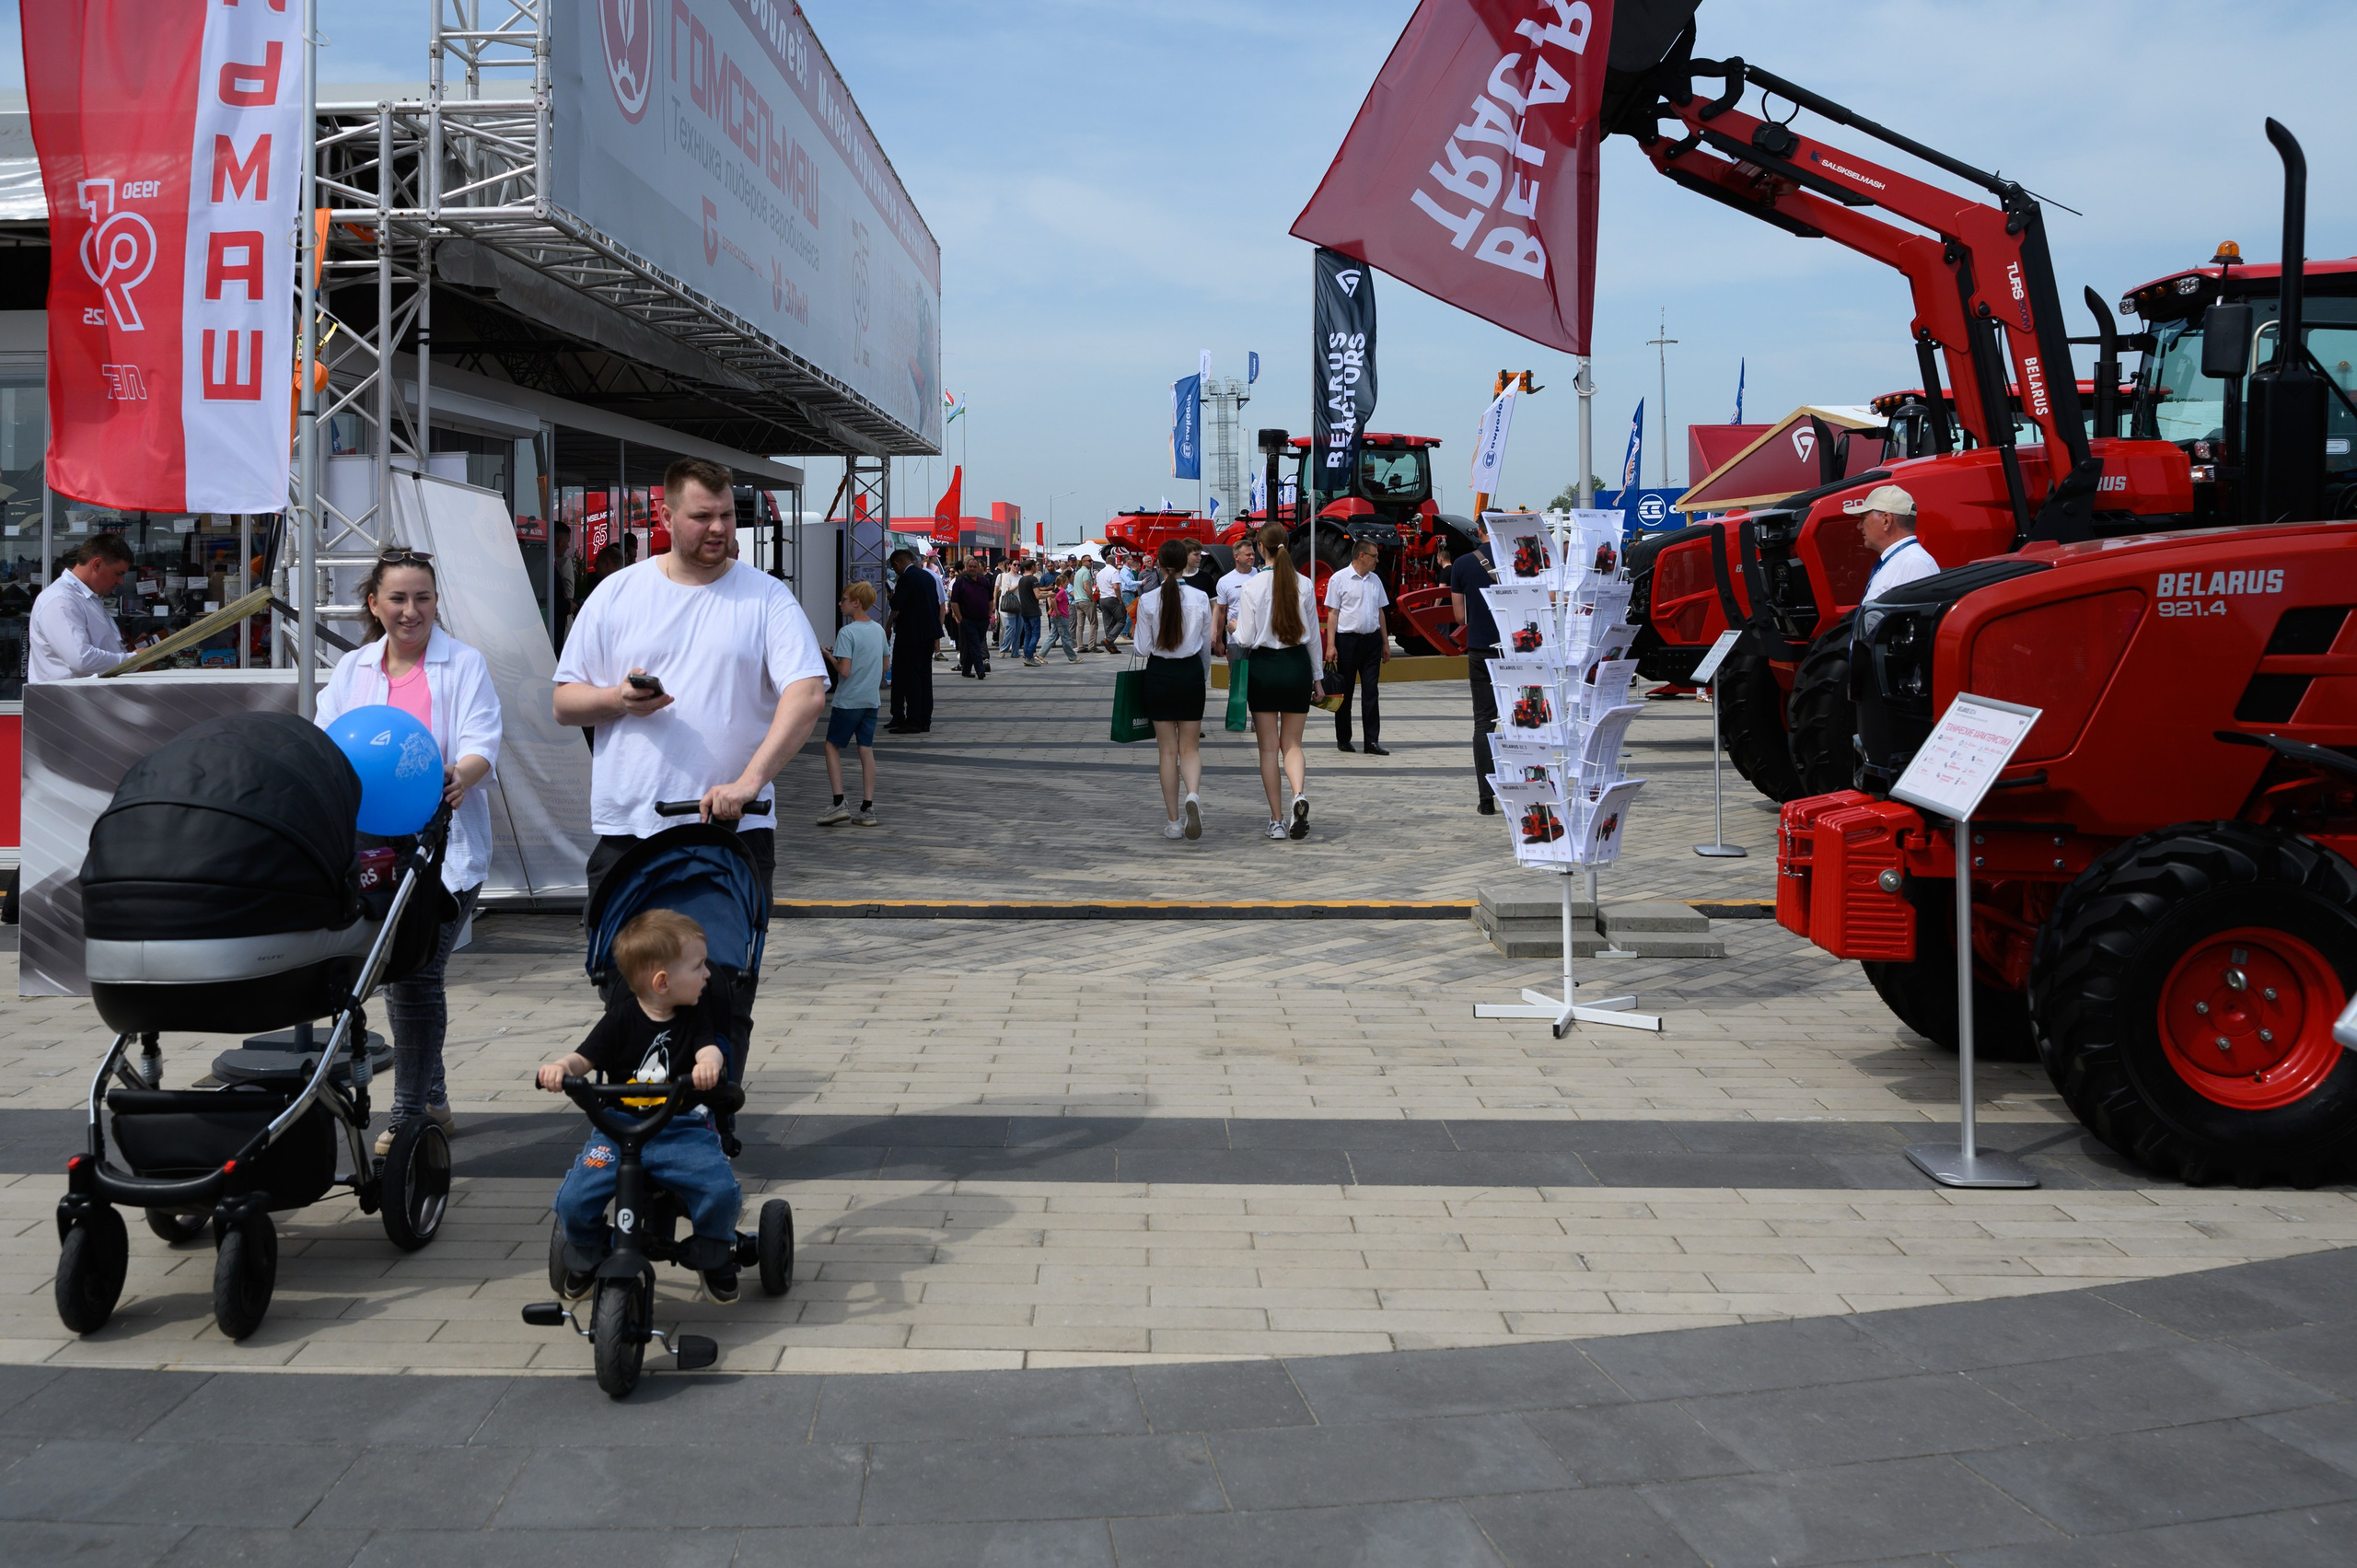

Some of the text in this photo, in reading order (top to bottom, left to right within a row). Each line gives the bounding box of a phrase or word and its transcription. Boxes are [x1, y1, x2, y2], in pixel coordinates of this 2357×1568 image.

[671, 0, 819, 230] ГОМСЕЛЬМАШ
[817, 69, 852, 155] Много
[671, 94, 820, 273] Техника лидеров агробизнеса
[1820, 158, 1887, 191] SALSKSELMASH
[2006, 261, 2025, 300] TURS
[1326, 331, 1347, 468] BELARUS
[2024, 356, 2049, 416] BELARUS
[2155, 568, 2285, 598] BELARUS
[2157, 599, 2227, 617] 921.4
